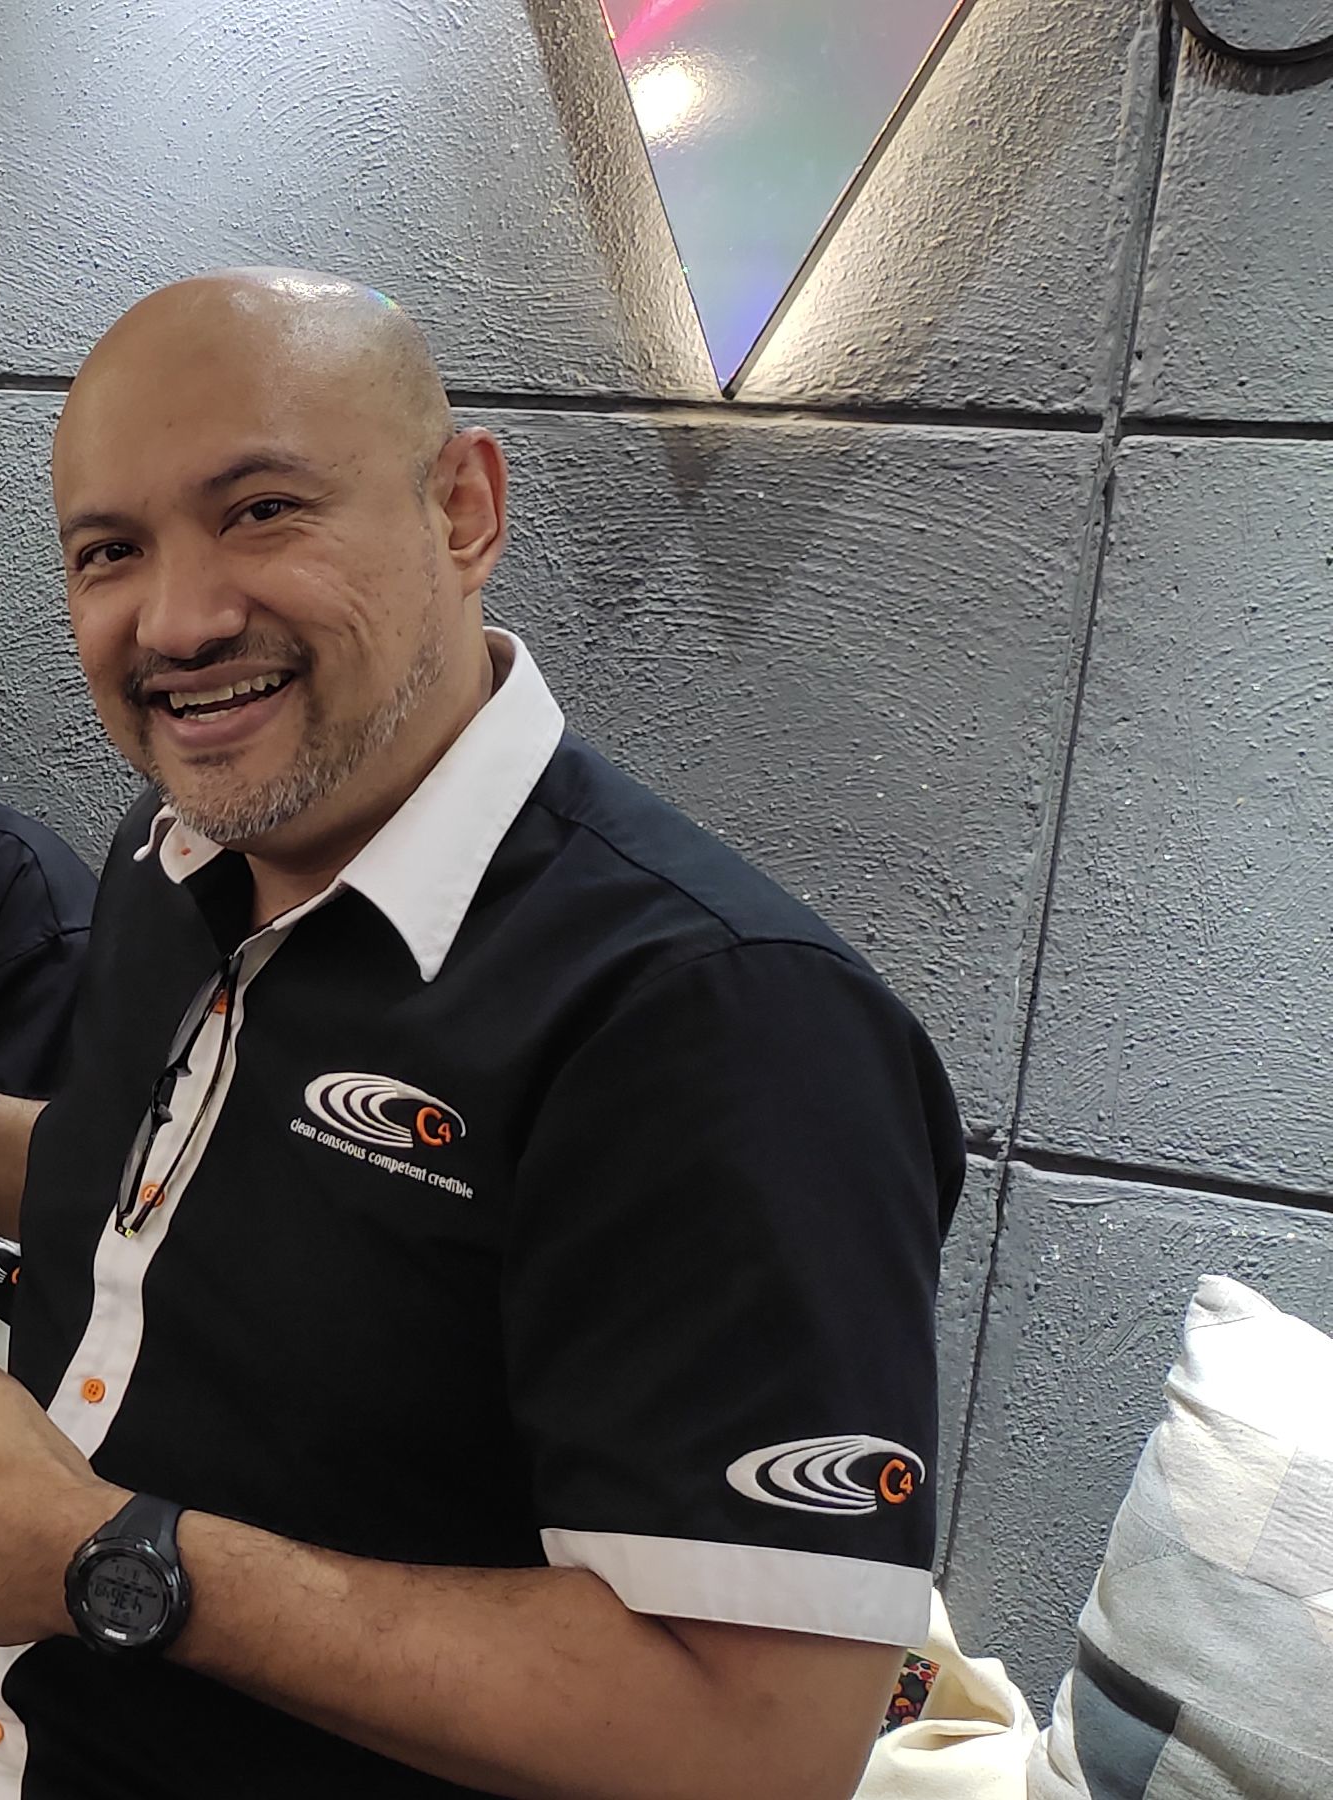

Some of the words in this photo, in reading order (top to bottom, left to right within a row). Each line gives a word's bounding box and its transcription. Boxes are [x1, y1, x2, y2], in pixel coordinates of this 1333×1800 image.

[416, 1106, 452, 1147] C4
[290, 1117, 317, 1140] clean
[317, 1130, 367, 1161] conscious
[368, 1151, 427, 1183] competent
[428, 1172, 474, 1200] credible
[879, 1458, 913, 1504] C4
